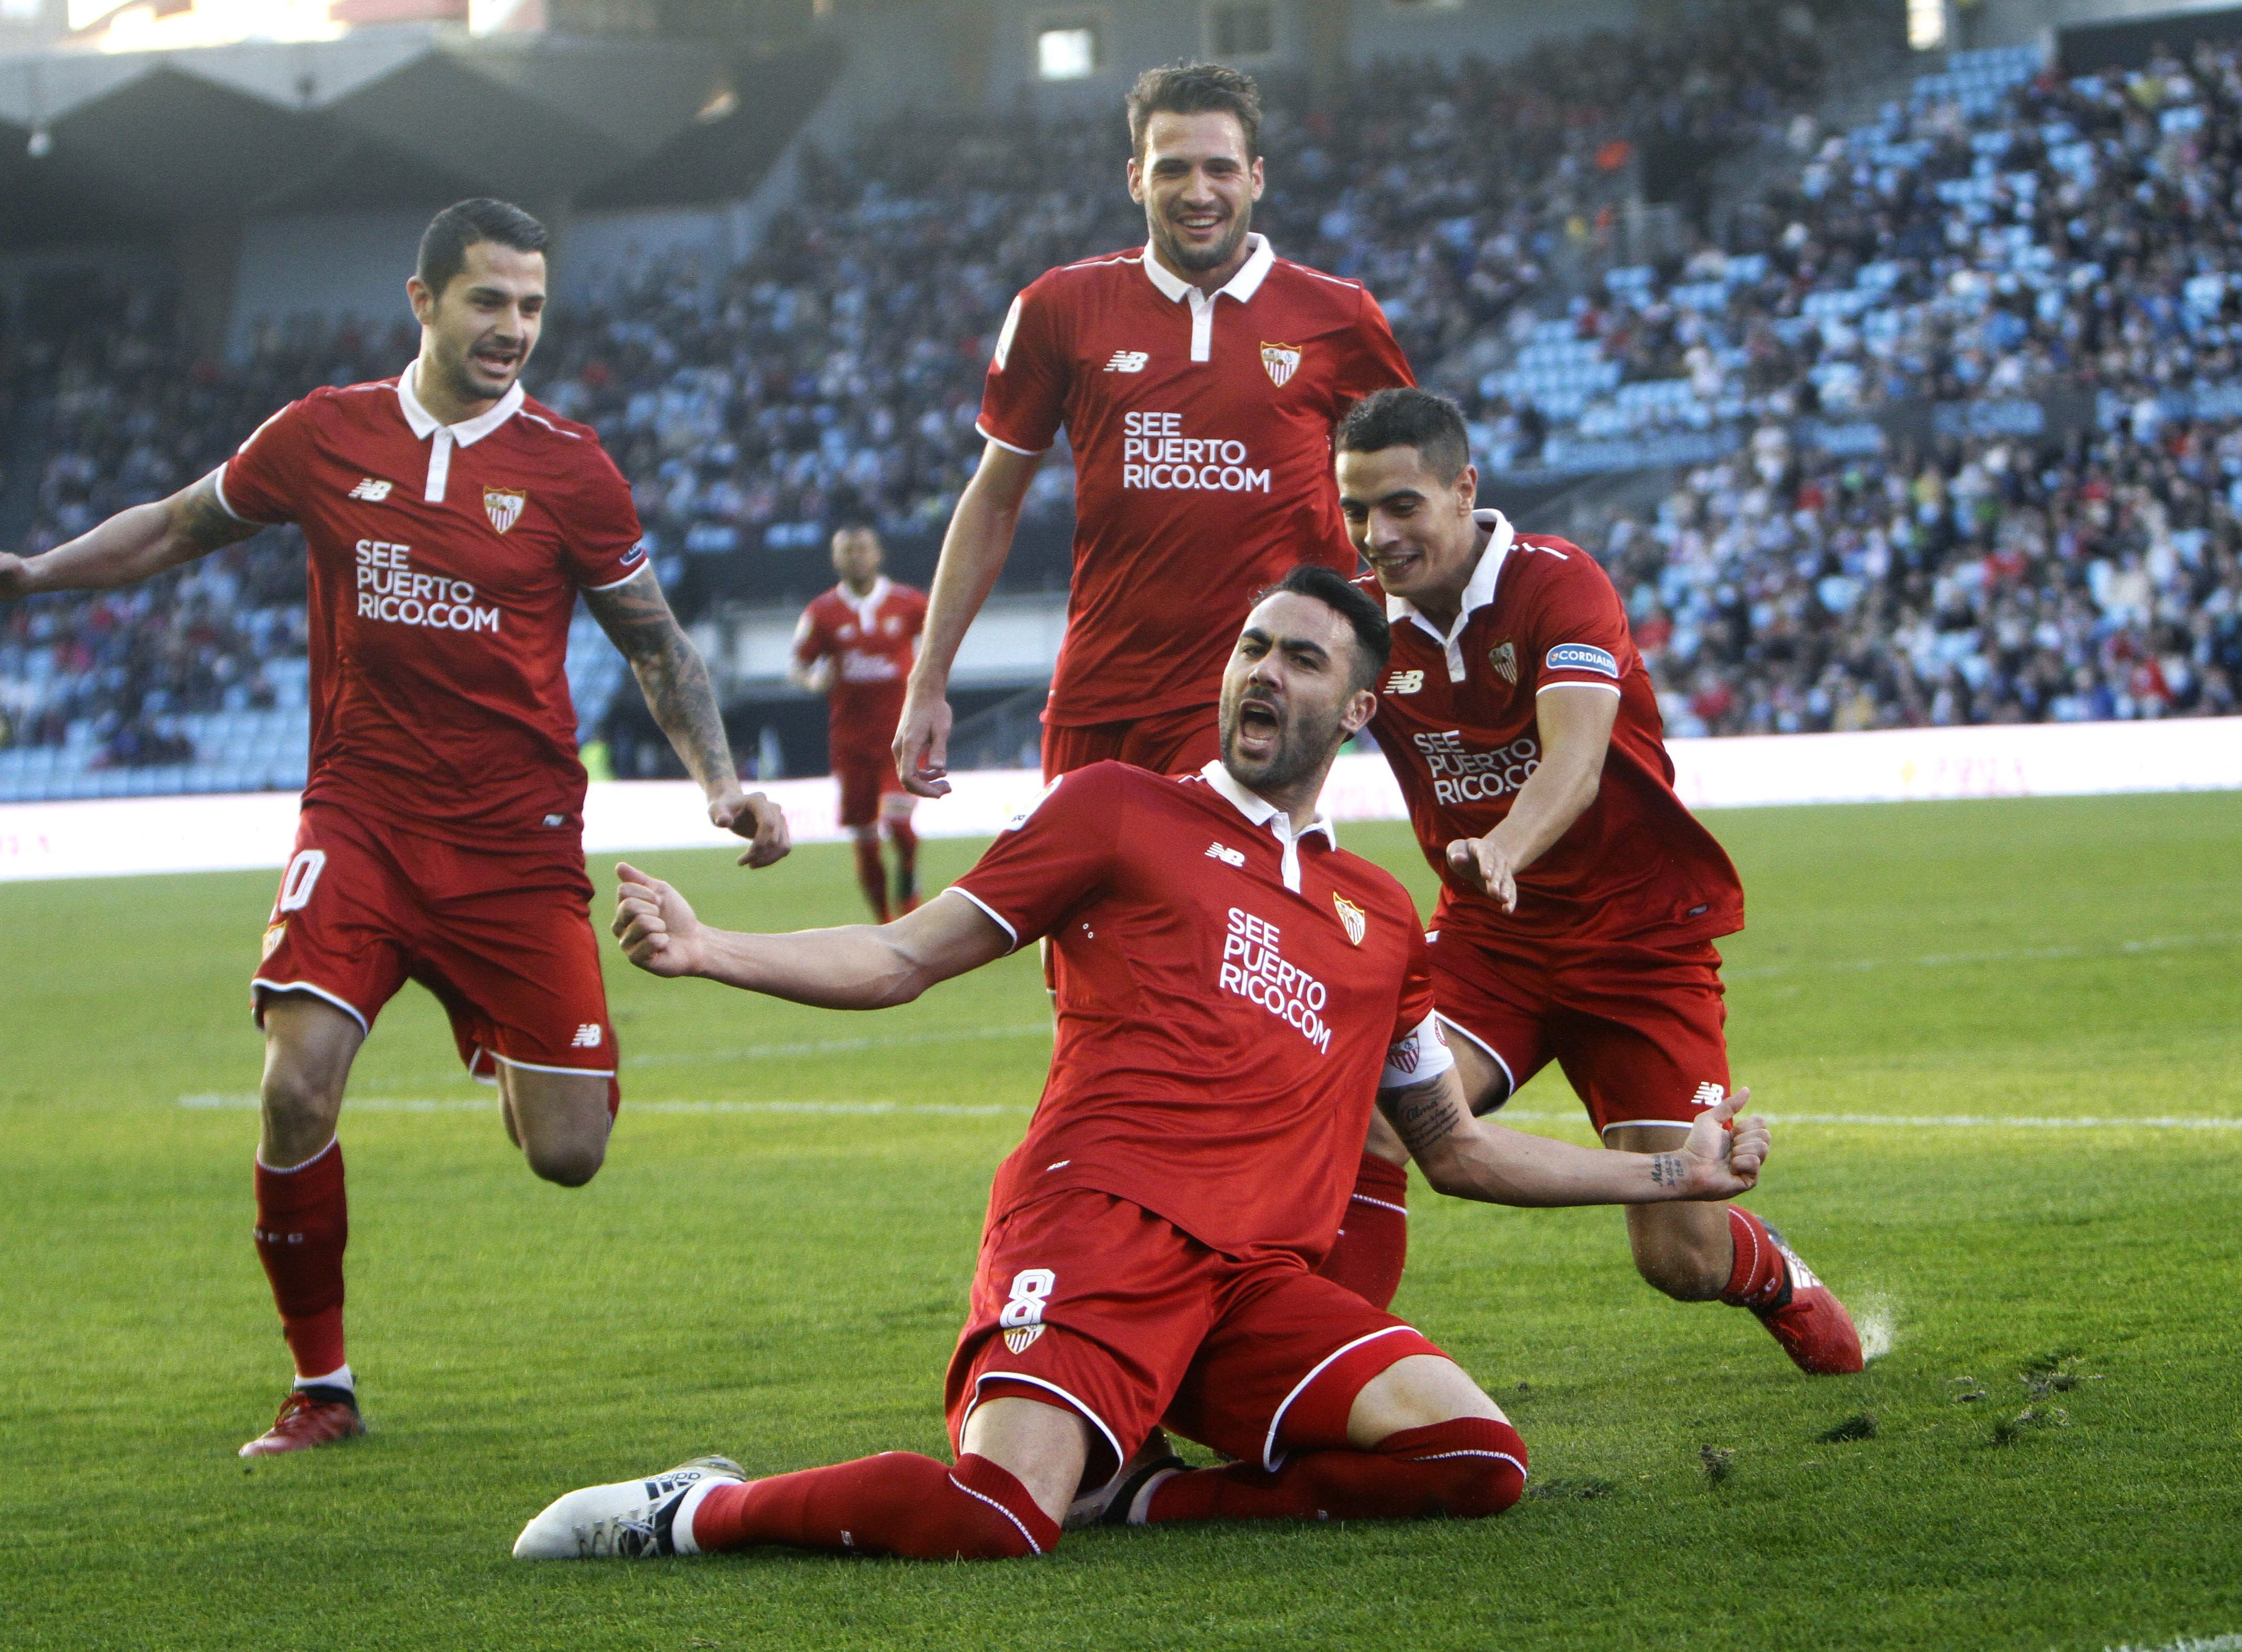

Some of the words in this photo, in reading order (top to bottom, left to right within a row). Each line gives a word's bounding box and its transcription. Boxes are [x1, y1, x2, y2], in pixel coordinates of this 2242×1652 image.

[1124, 411, 1182, 437] SEE
[1124, 438, 1246, 465] PUERTO
[1123, 464, 1270, 493] RICO.COM
[356, 539, 410, 571] SEE
[357, 566, 474, 604] PUERTO
[357, 592, 499, 633] RICO.COM
[1413, 729, 1465, 754] SEE
[1426, 738, 1536, 778] PUERTO
[1227, 907, 1280, 953] SEE
[1223, 933, 1326, 1011] PUERTO
[1219, 961, 1332, 1054] RICO.COM
[999, 1269, 1056, 1328] 8
